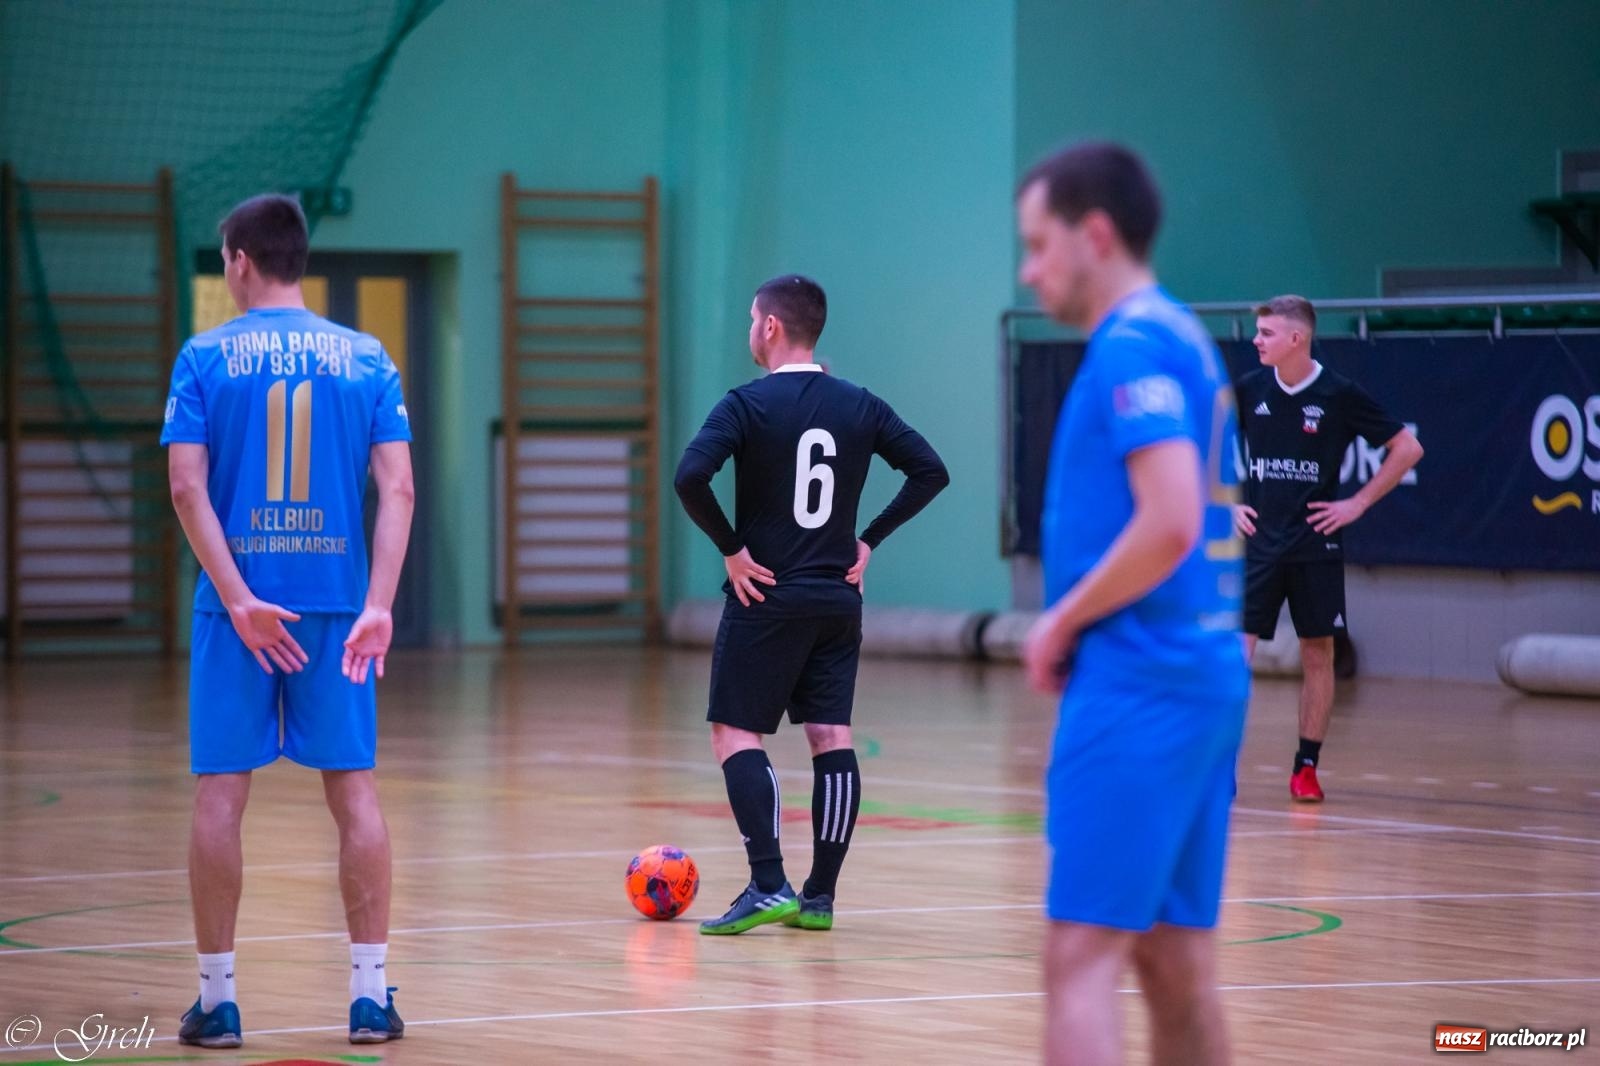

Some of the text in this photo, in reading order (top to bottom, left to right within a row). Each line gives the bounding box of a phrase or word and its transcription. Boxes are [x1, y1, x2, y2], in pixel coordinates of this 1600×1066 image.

[220, 331, 353, 359] FIRMA BAGER
[227, 352, 264, 378] 607
[270, 352, 308, 376] 931
[266, 379, 312, 502] 11
[793, 428, 837, 529] 6
[250, 507, 324, 532] KELBUD
[269, 536, 347, 555] BRUKARSKIE
